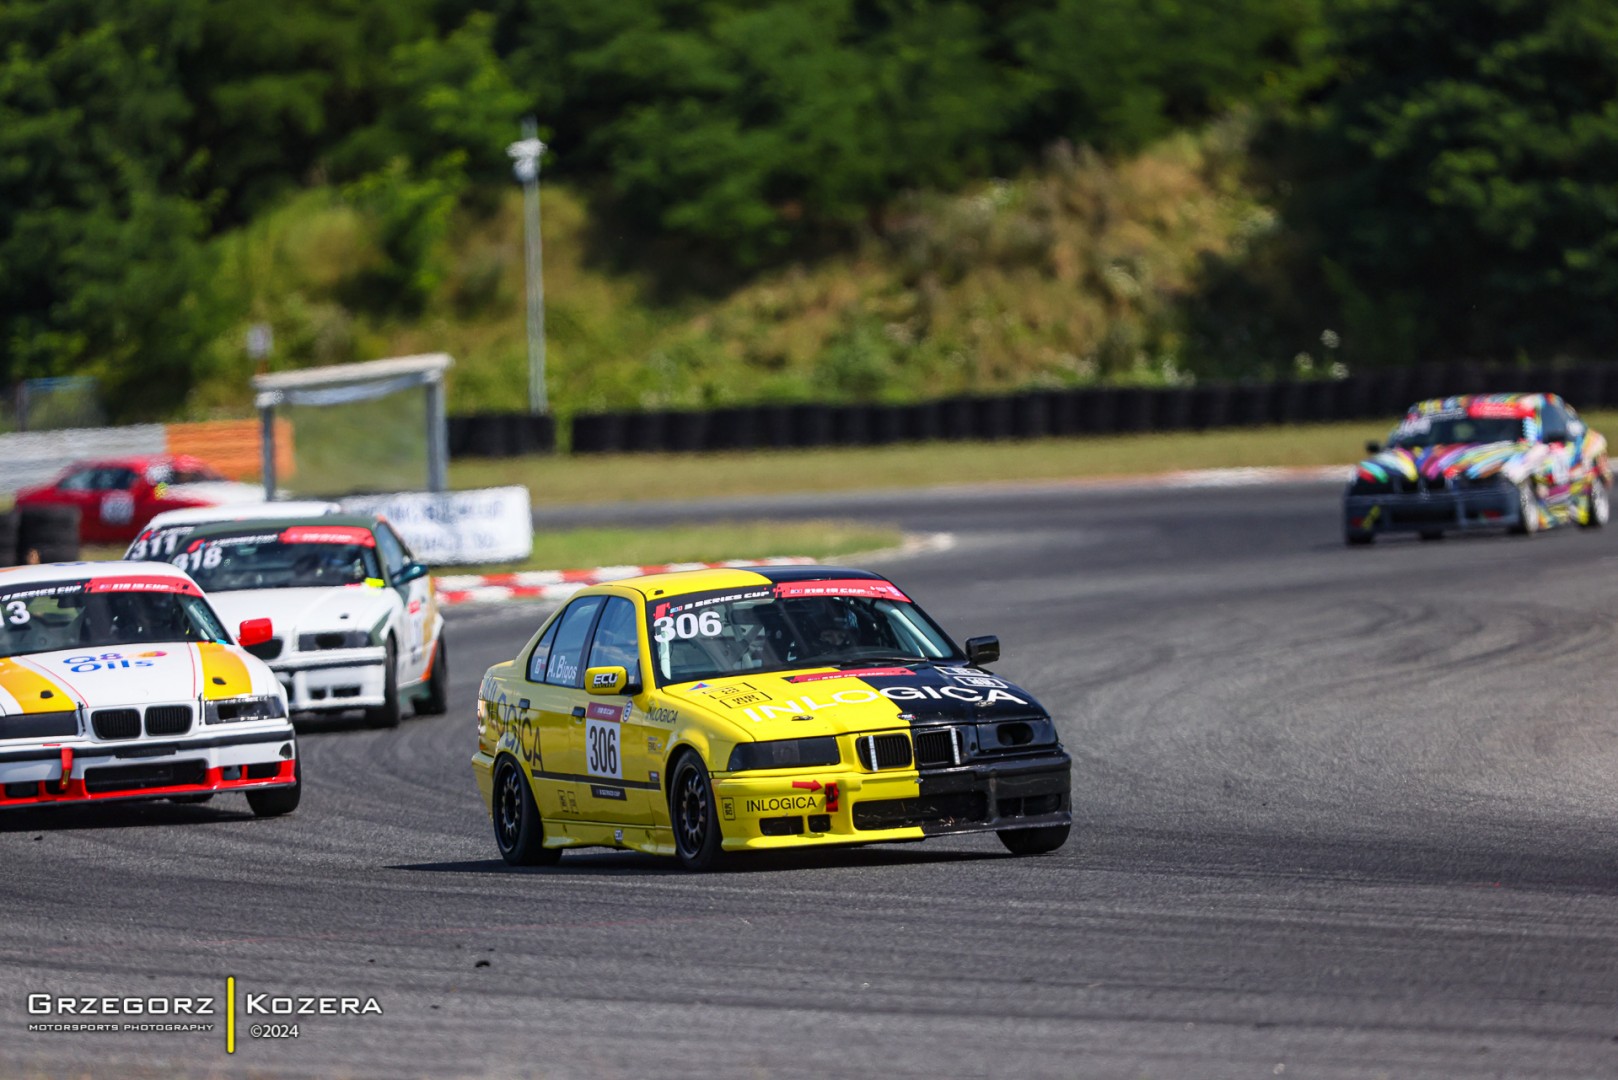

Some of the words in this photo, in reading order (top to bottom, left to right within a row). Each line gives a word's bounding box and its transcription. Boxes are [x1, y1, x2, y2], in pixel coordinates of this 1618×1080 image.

[653, 611, 722, 642] 306
[63, 653, 123, 664] Q8
[71, 660, 154, 673] Oils
[594, 673, 618, 684] ECU
[743, 685, 1028, 722] INLOGICA
[589, 726, 617, 774] 306
[746, 796, 817, 813] INLOGICA
